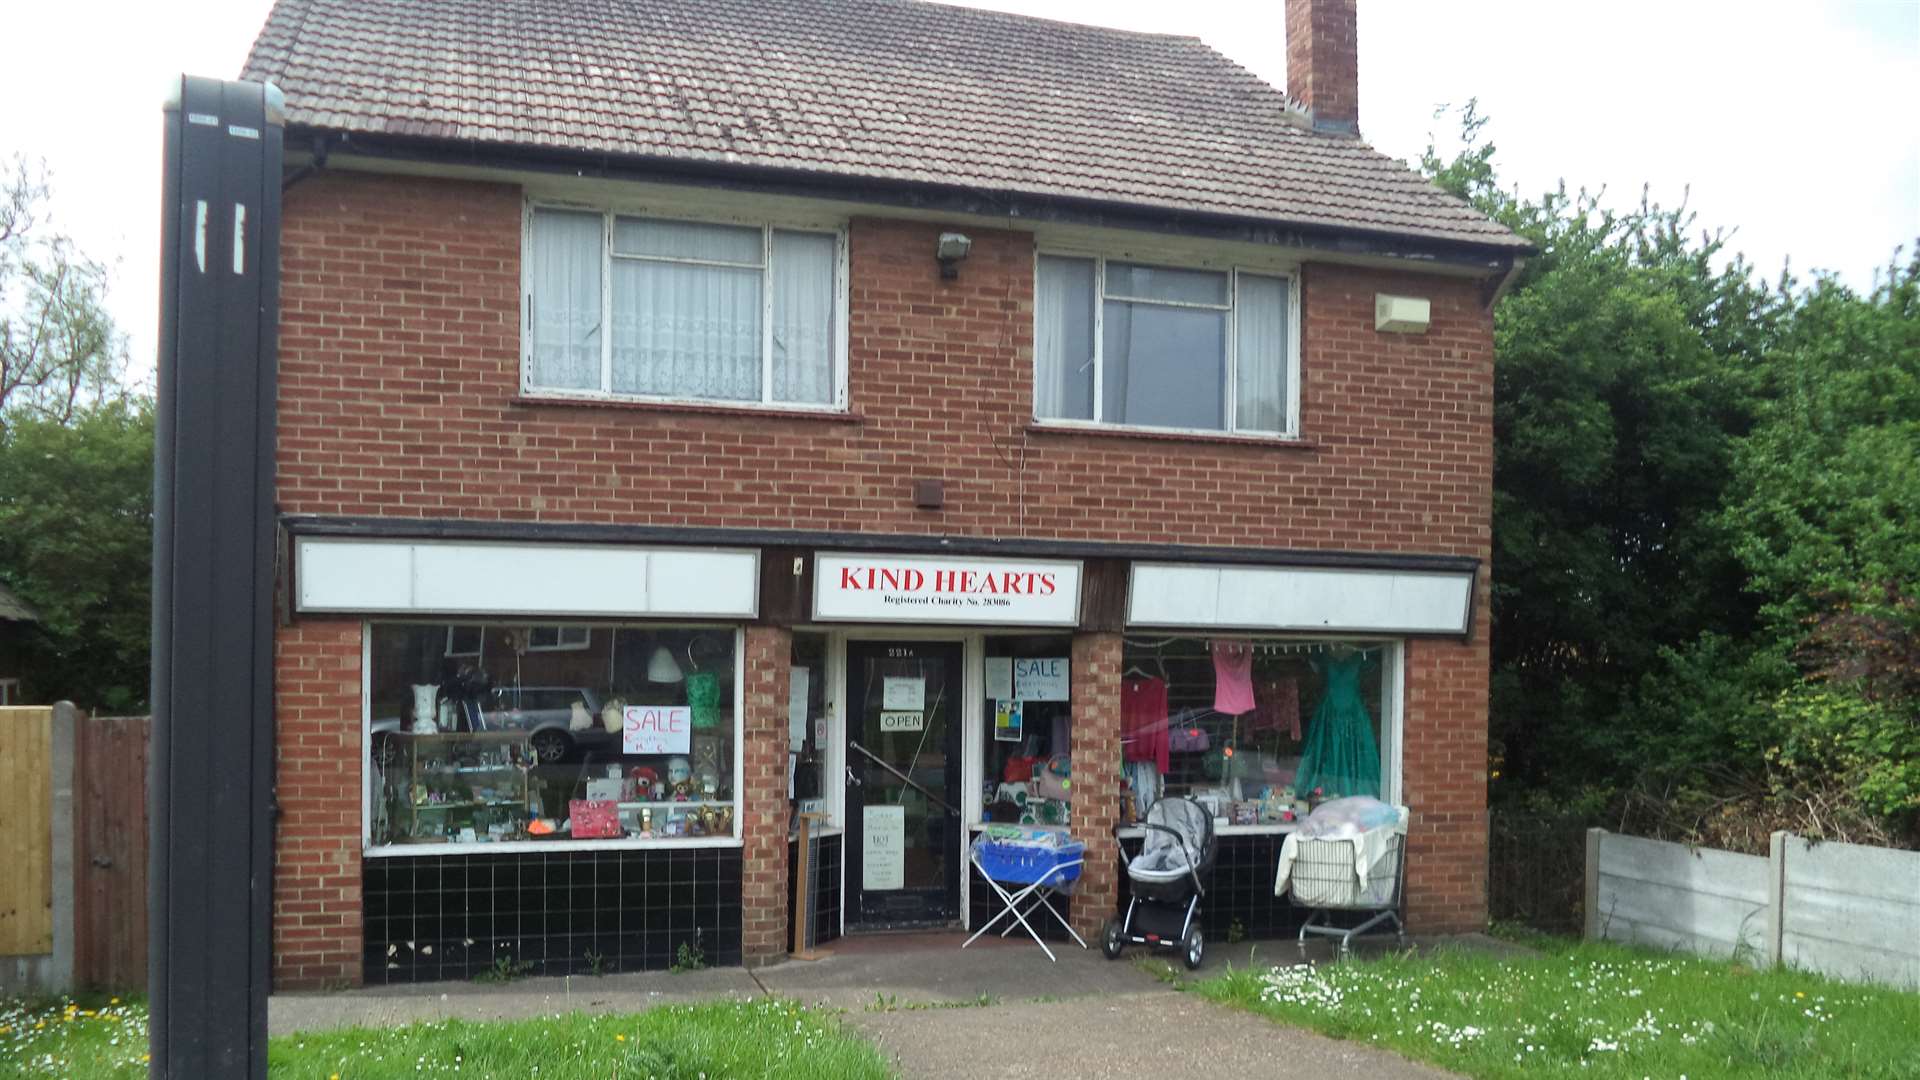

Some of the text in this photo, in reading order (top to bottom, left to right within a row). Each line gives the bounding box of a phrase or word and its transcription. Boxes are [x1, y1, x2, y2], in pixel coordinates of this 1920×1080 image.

[841, 567, 1056, 595] KIND HEARTS
[884, 595, 929, 605] Registered
[931, 596, 963, 607] Charity
[967, 598, 980, 606] No.
[1017, 659, 1060, 677] SALE
[627, 709, 683, 733] SALE
[885, 715, 920, 727] OPEN
